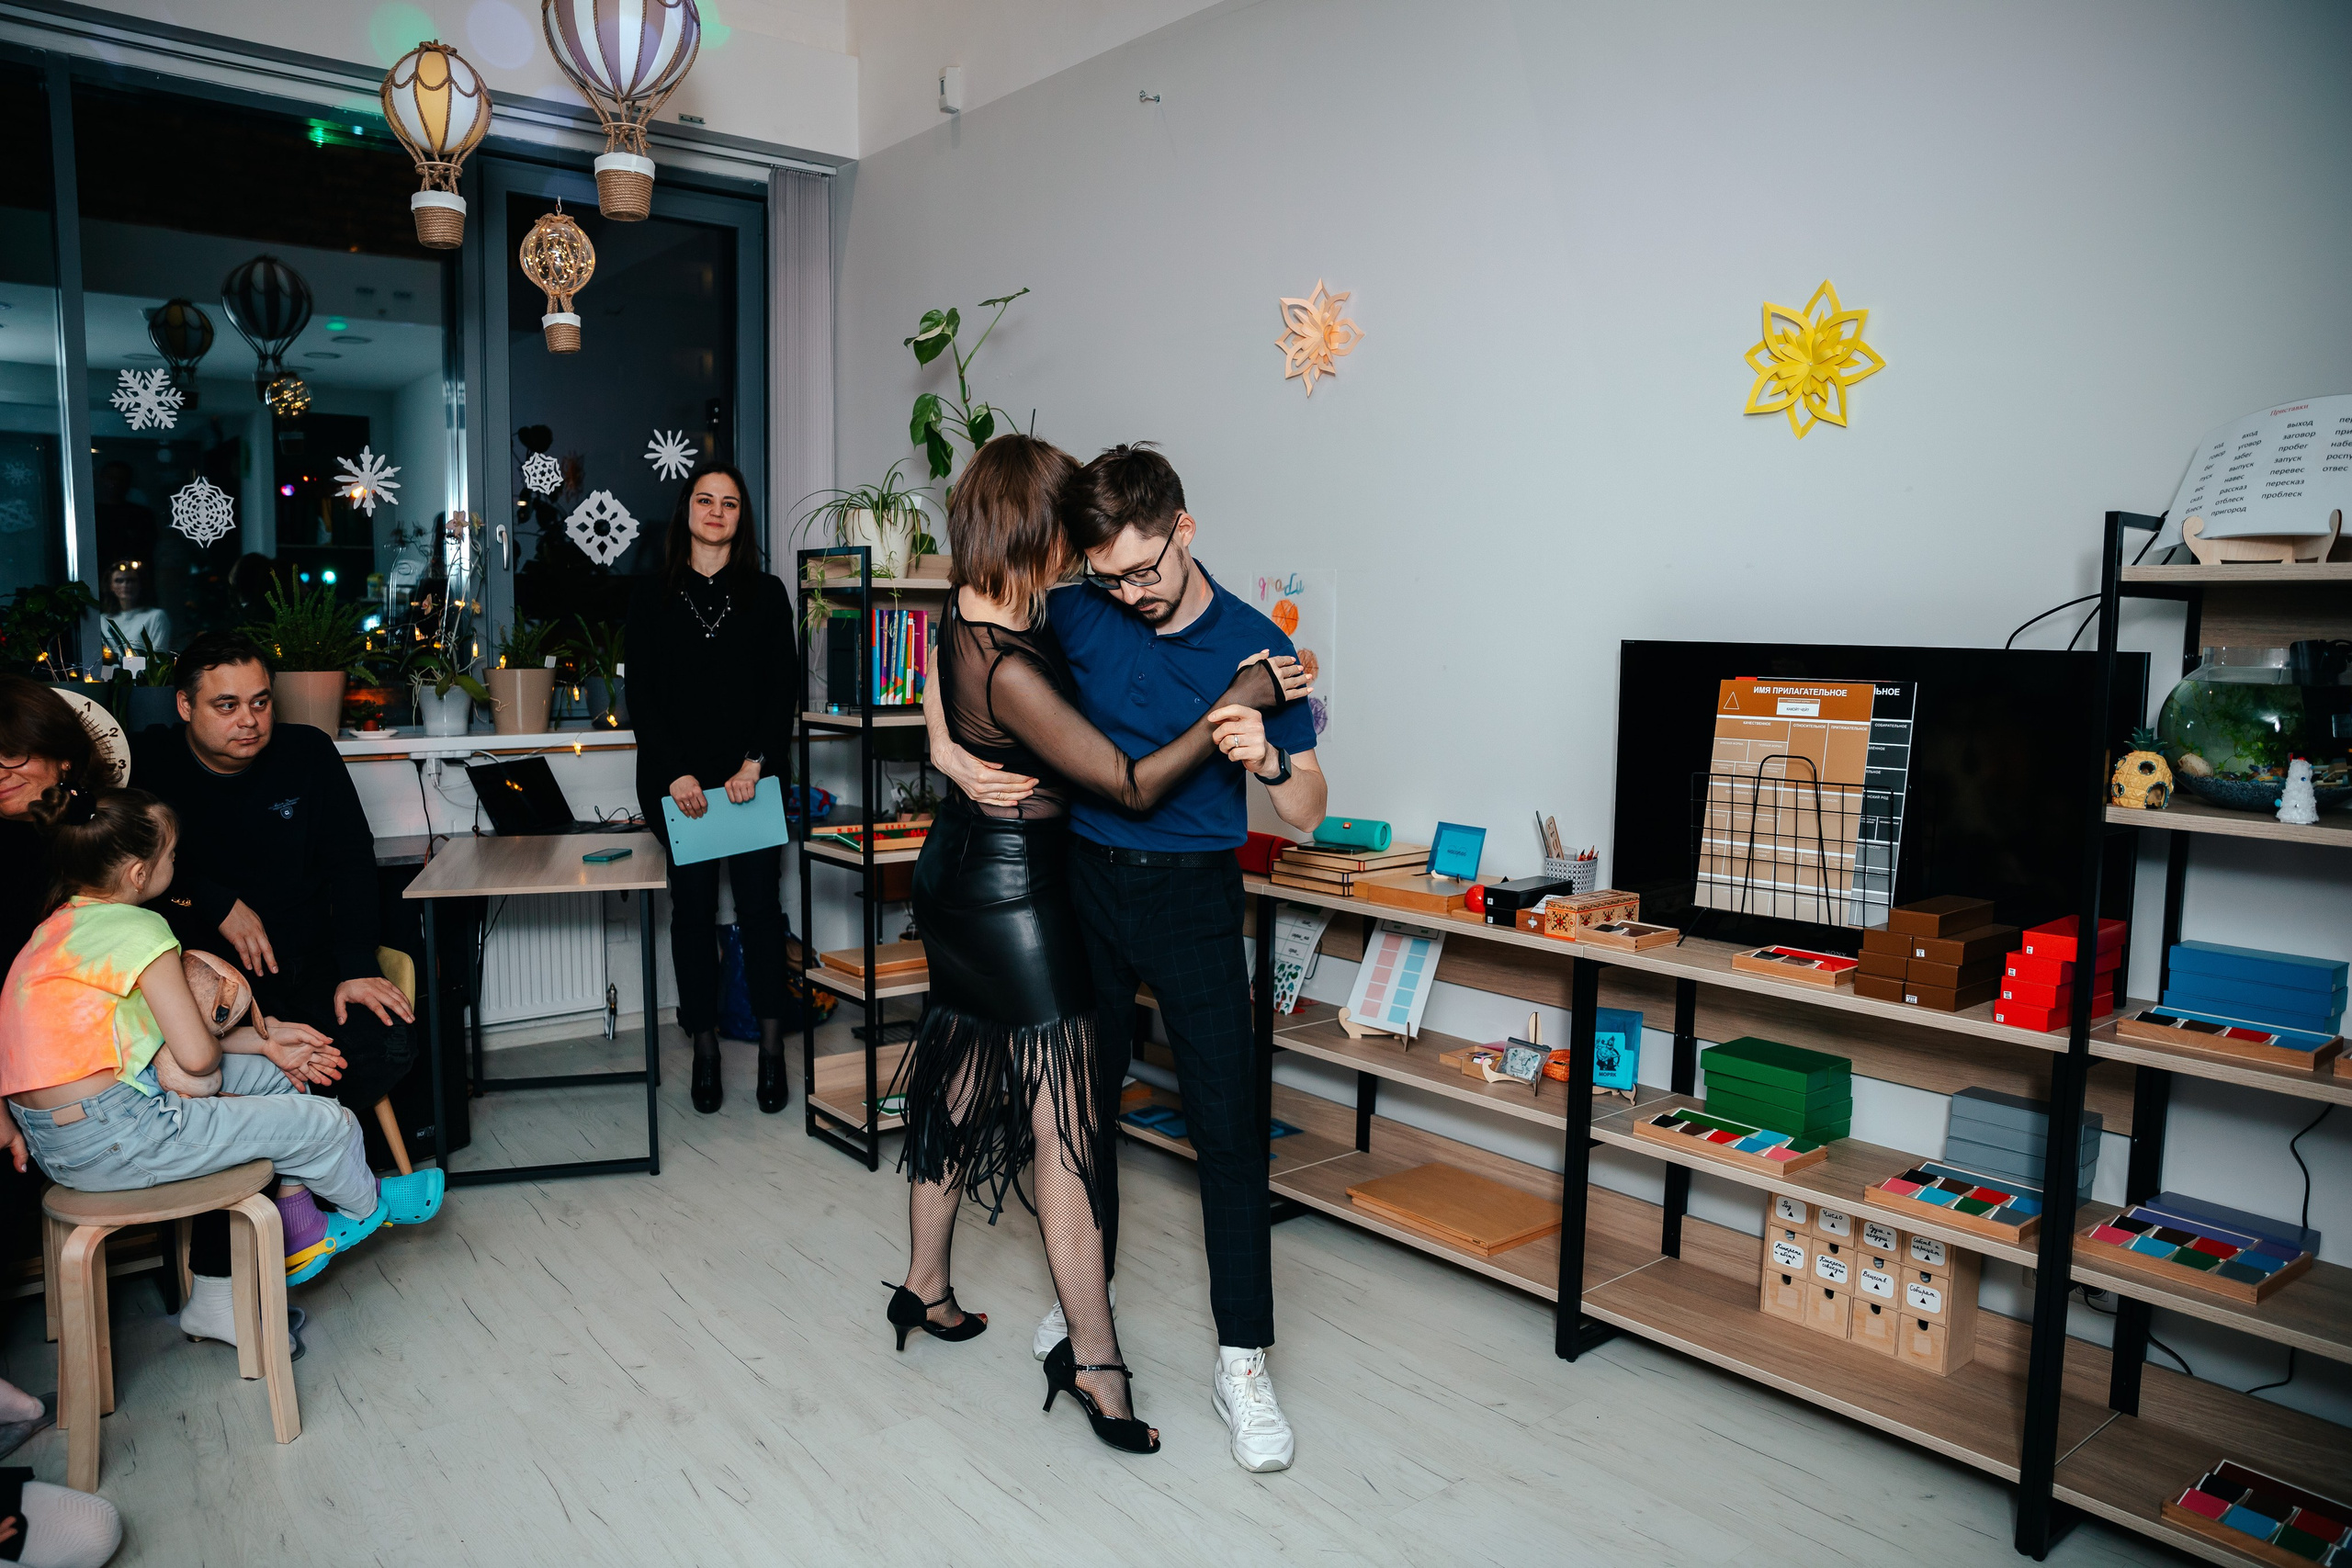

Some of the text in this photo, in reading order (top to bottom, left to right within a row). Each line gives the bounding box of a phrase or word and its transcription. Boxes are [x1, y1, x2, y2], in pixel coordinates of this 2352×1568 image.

[2270, 404, 2309, 416] Приставки
[2242, 430, 2258, 439] вход
[2287, 420, 2313, 429] выход
[2209, 450, 2226, 460] говор
[2237, 440, 2261, 451] уговор
[2282, 432, 2316, 440] заговор
[2204, 463, 2215, 471] бег
[2233, 451, 2253, 461] забег
[2278, 443, 2309, 452] пробег
[2199, 474, 2213, 482] пуск
[2229, 462, 2255, 472] выпуск
[2274, 456, 2302, 464] запуск
[2195, 485, 2205, 493] вес
[2224, 474, 2245, 483] навес
[2269, 467, 2305, 476] перевес
[2189, 479, 2305, 503] сказ рассказ пересказ
[2185, 491, 2302, 514] блеск отблеск проблеск
[2211, 506, 2247, 517] пригород
[1753, 686, 1848, 697] ИМЯ ПРИЛАГАТЕЛЬНОЕ
[85, 701, 91, 712] 1
[109, 728, 119, 737] 2
[119, 760, 126, 769] 3
[1781, 1200, 1792, 1212] Род
[1823, 1210, 1843, 1221] Число
[1909, 1284, 1938, 1298] Собират.
